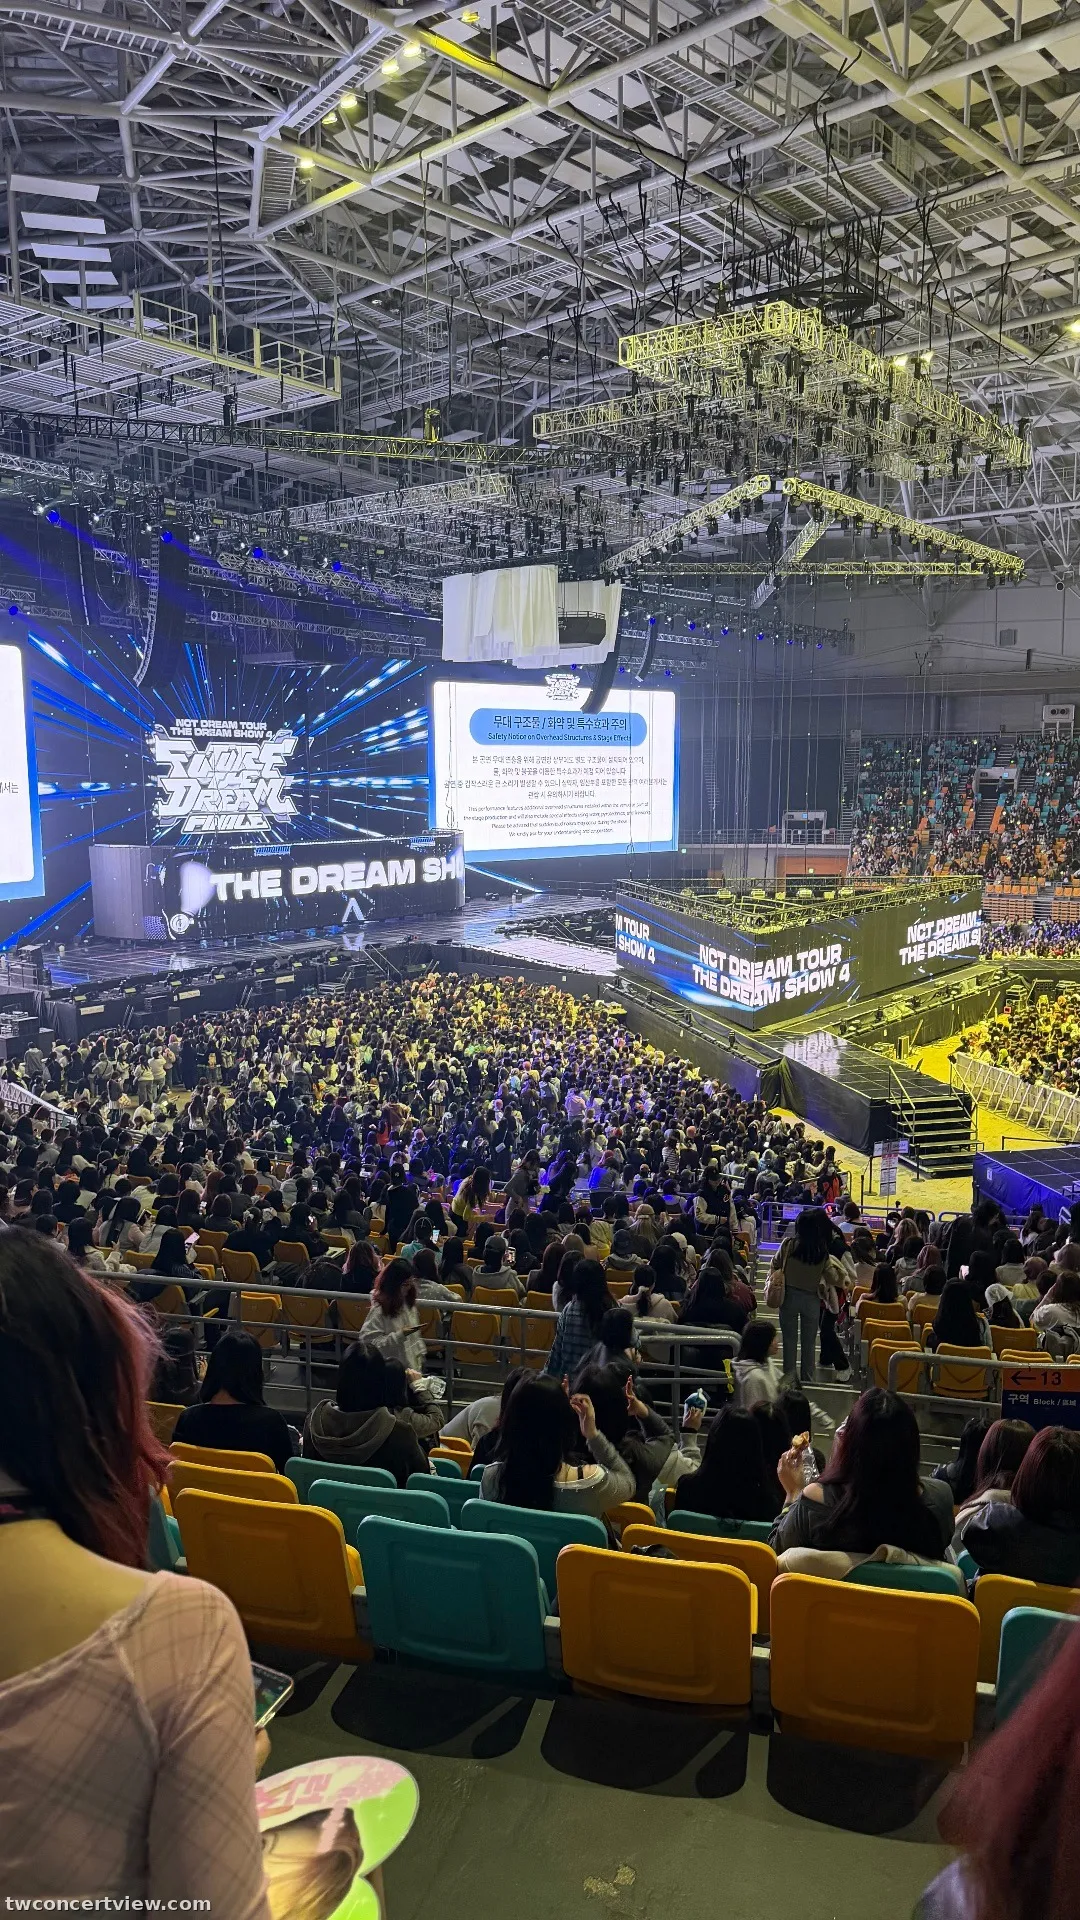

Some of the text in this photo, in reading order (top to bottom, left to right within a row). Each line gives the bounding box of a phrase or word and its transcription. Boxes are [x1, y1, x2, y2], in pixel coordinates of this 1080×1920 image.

[170, 726, 192, 736] THE
[194, 728, 233, 737] DREAM
[234, 729, 264, 738] SHOW
[200, 720, 238, 729] DREAM
[239, 721, 267, 731] TOUR
[494, 715, 512, 729] 무대
[513, 716, 540, 729] 구조물
[547, 717, 565, 730] 화약
[566, 717, 575, 730] 및
[577, 717, 609, 730] 특수효과
[611, 718, 627, 730] 주의
[488, 733, 507, 741] Safety
[536, 733, 563, 741] Overhead
[564, 733, 592, 741] Structures
[598, 734, 612, 743] Stage
[155, 737, 299, 779] FUTURE
[158, 778, 299, 816] DREAM
[209, 869, 283, 902] THE
[291, 859, 416, 896] DREAM
[623, 917, 650, 942] TOUR
[907, 910, 978, 945] NCT DREAM
[618, 934, 656, 964] SHOW 4
[699, 943, 843, 984] NCT DREAM TOUR
[899, 943, 926, 966] THE
[927, 931, 970, 959] DREAM
[692, 962, 851, 1008] THE DREAM SHOW 4
[1041, 1371, 1062, 1386] 13
[1008, 1393, 1030, 1405] 구역
[1033, 1398, 1055, 1406] Block
